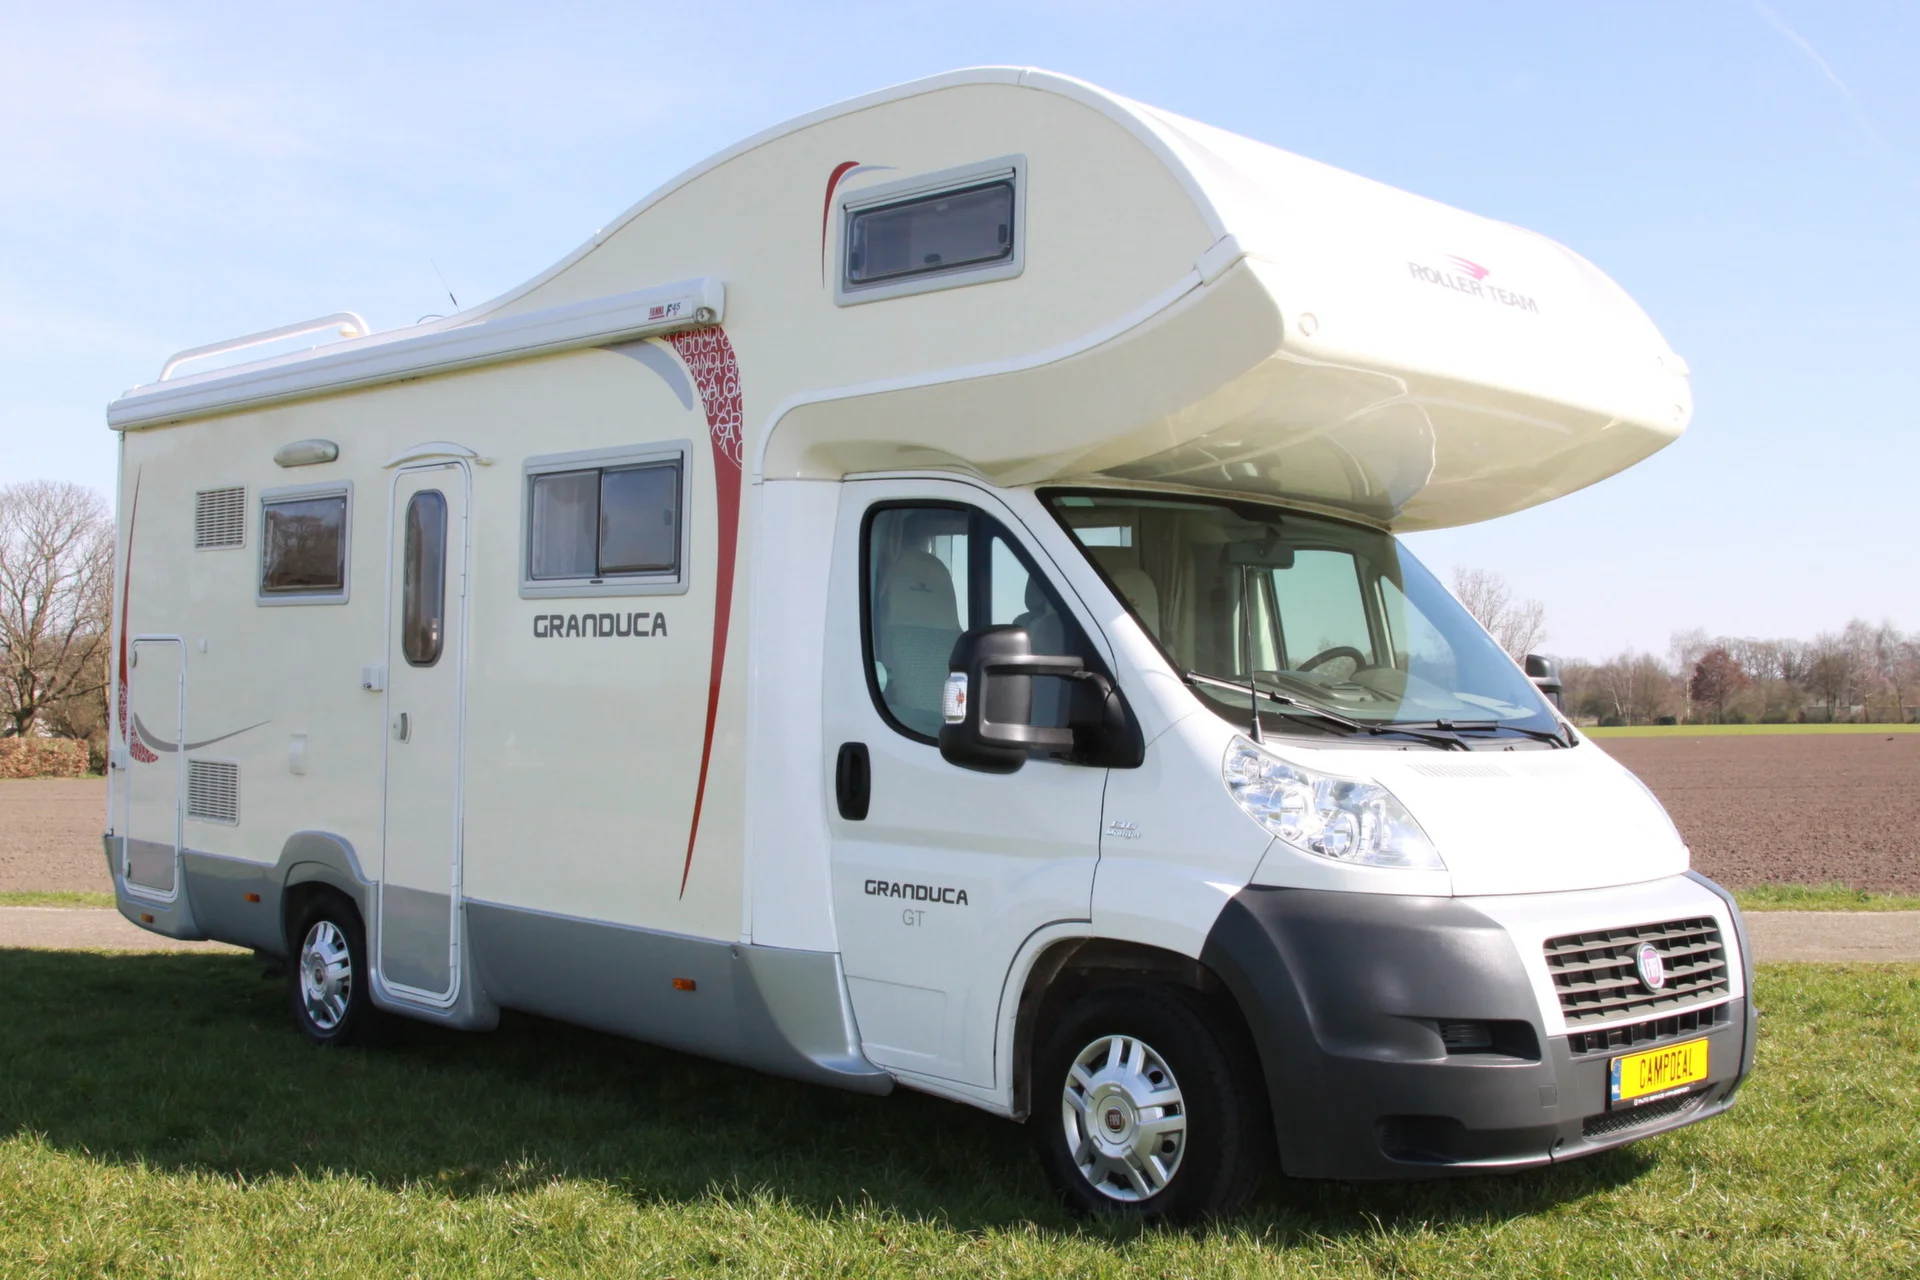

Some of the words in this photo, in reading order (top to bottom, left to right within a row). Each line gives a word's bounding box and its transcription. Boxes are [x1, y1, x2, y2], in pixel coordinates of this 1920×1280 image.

[1407, 260, 1485, 299] ROLLER
[1486, 284, 1540, 314] TEAM
[533, 611, 668, 638] GRANDUCA
[864, 879, 969, 906] GRANDUCA
[902, 908, 926, 927] GT
[1640, 1047, 1693, 1089] CAMPDEAL
